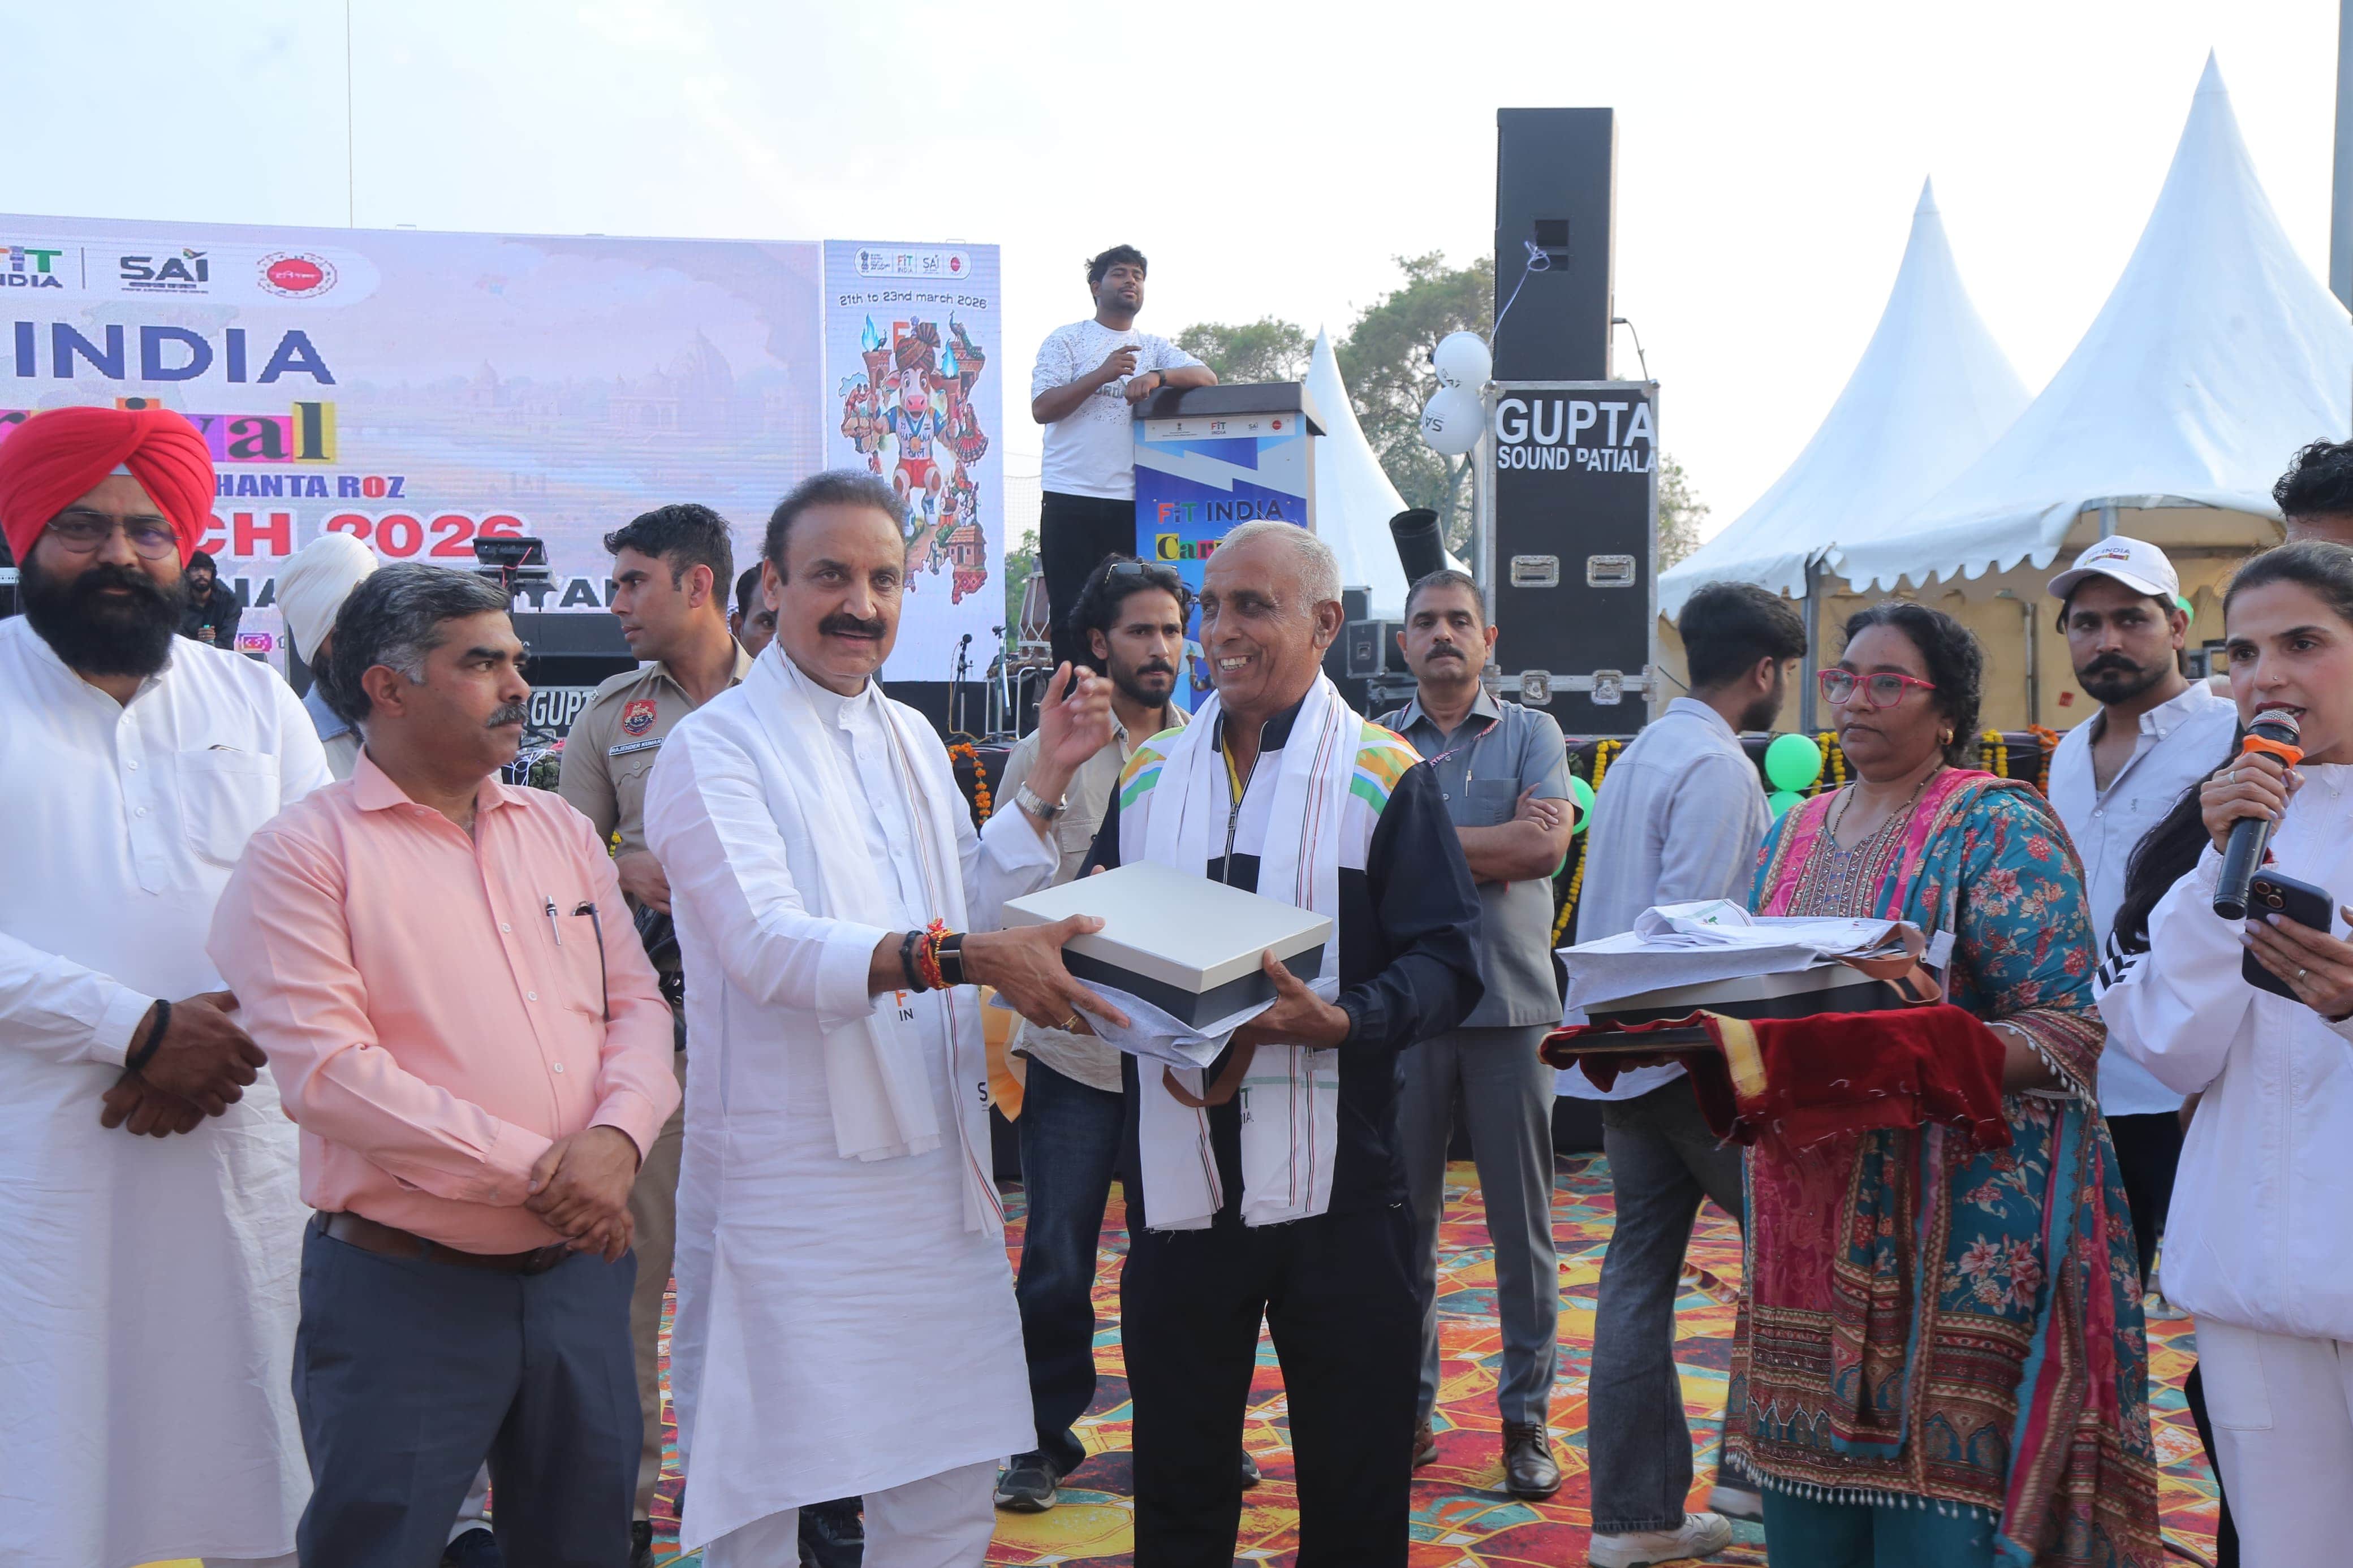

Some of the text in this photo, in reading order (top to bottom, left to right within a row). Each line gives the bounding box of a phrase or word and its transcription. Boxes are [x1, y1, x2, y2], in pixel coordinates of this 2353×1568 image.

[867, 293, 878, 302] to
[883, 291, 912, 301] 23nd
[916, 292, 954, 304] march
[957, 295, 988, 309] 2026
[15, 321, 336, 385] INDIA
[1496, 398, 1658, 447] GUPTA
[1498, 446, 1570, 470] SOUND
[216, 473, 405, 498] HANTA ROZ
[1206, 499, 1283, 521] INDIA
[1157, 536, 1222, 559] Car
[611, 738, 661, 753] RAJENDER KUMAR
